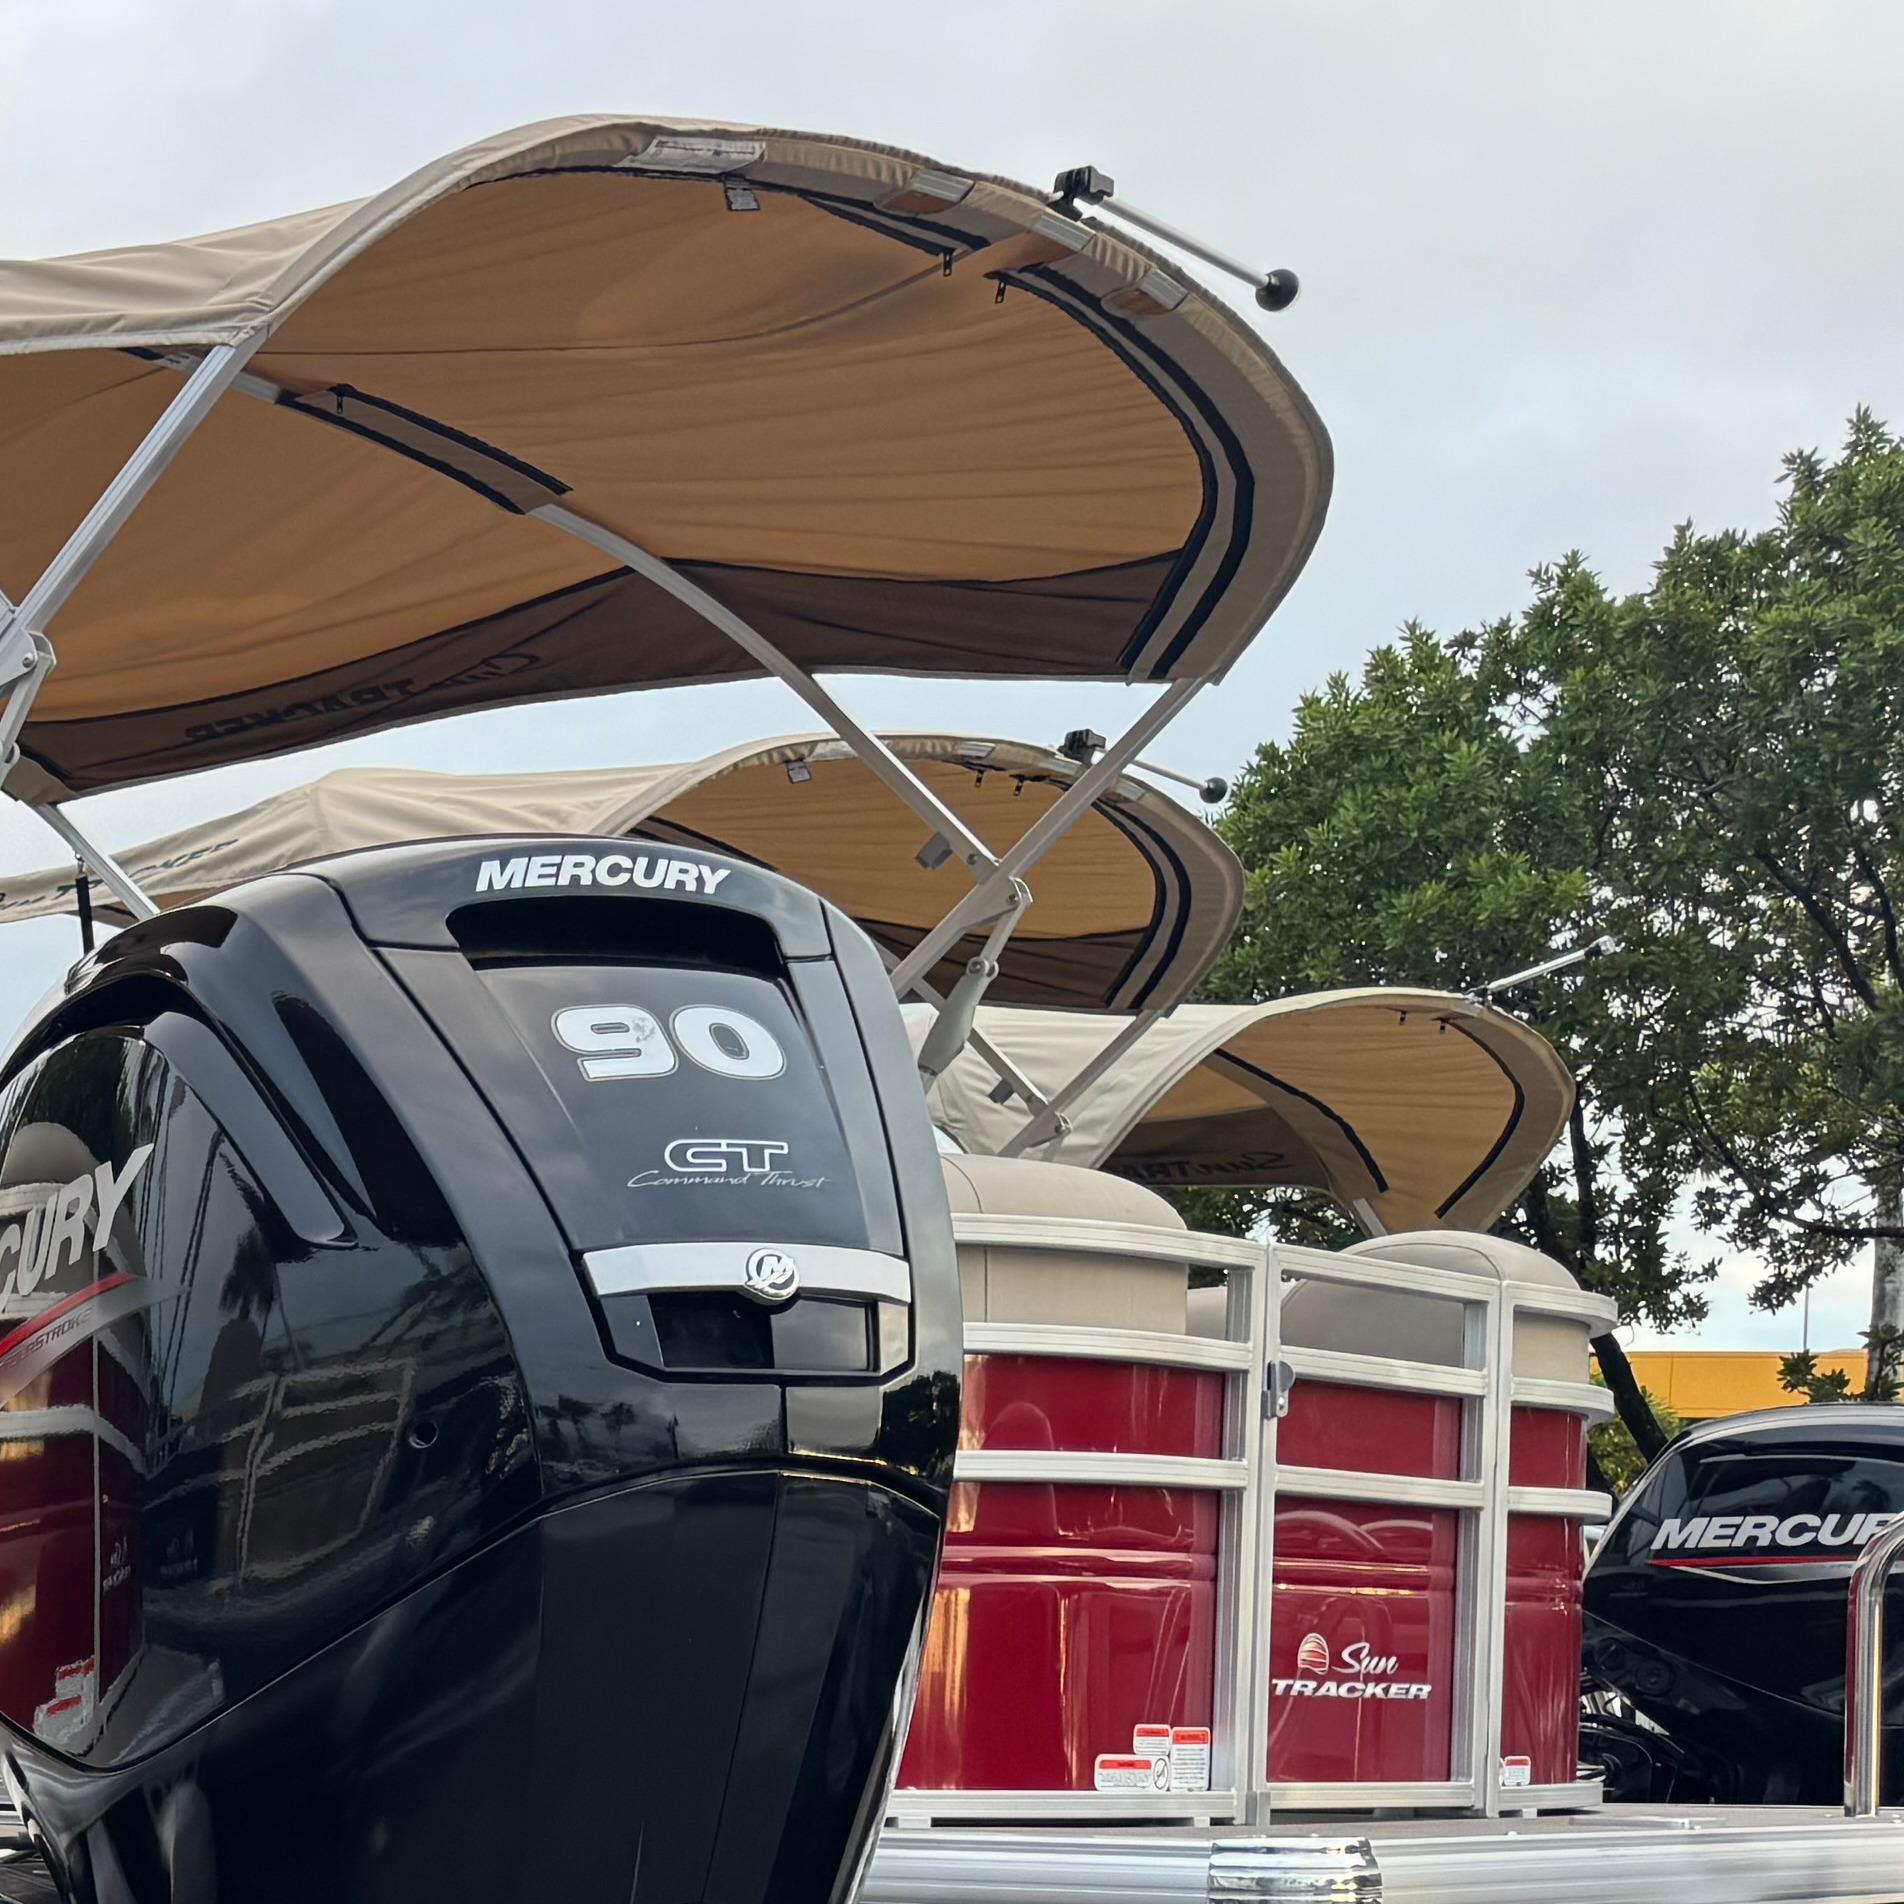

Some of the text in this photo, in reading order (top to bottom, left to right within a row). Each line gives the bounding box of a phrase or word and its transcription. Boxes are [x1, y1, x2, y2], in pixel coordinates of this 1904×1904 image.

[475, 854, 731, 896] MERCURY
[550, 1004, 787, 1082] 90
[626, 1170, 832, 1188] Command Thrust
[1649, 1513, 1898, 1550] MERCU
[1330, 1642, 1399, 1675] Sun
[1271, 1678, 1432, 1700] TRACKER
